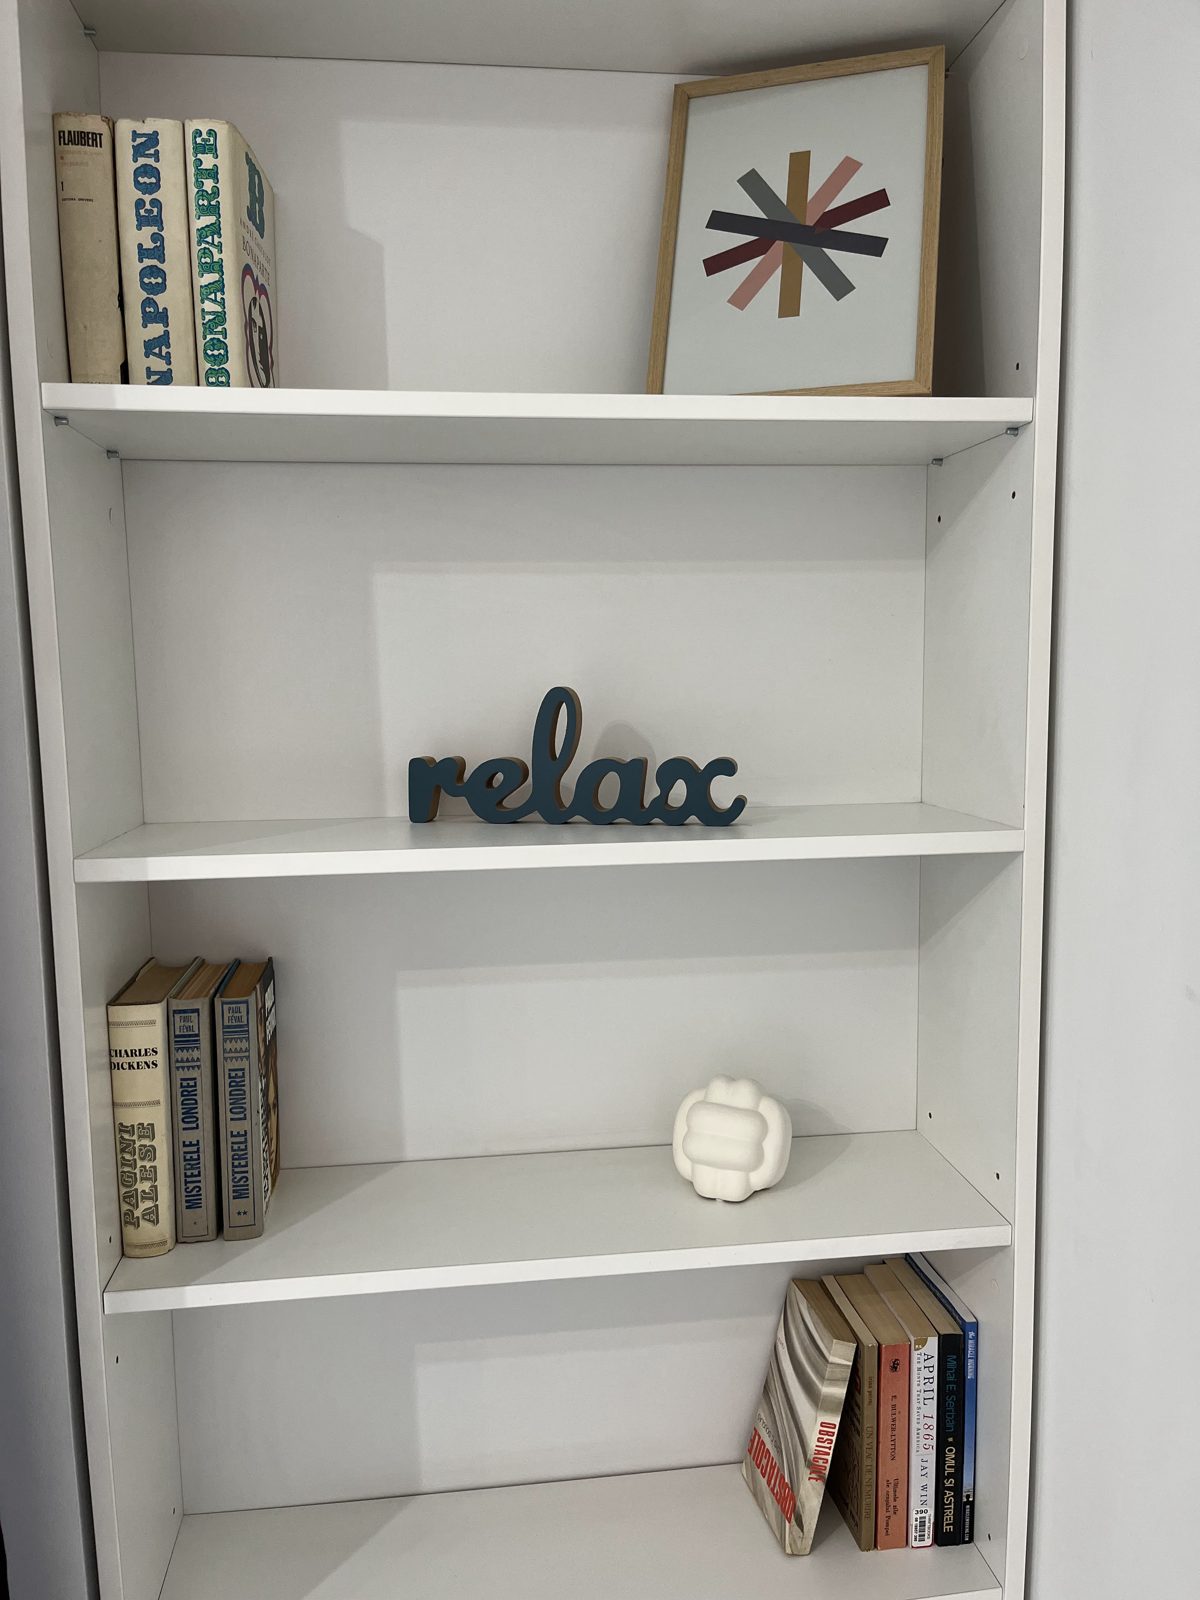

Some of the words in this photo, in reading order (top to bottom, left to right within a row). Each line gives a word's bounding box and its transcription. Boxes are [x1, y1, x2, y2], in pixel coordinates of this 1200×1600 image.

[58, 130, 104, 148] FLAUBERT
[131, 129, 174, 386] NAPOLEON
[191, 128, 231, 387] BONAPARTE
[408, 686, 748, 826] relax
[179, 1015, 193, 1024] PAUL
[227, 1006, 242, 1015] PAUL
[109, 1046, 159, 1059] CHARLES
[109, 1059, 159, 1071] DICKENS
[179, 1077, 200, 1132] LONDREI
[228, 1068, 247, 1121] LONDREI
[118, 1121, 141, 1229] PAGINI
[136, 1122, 160, 1226] ALESE
[183, 1139, 202, 1210] MISTERELE
[230, 1129, 250, 1200] MISTERELE
[922, 1352, 935, 1406] APRIL
[946, 1355, 957, 1381] Mihai
[808, 1421, 837, 1484] OBSTACOLE
[922, 1414, 934, 1450] 1865
[920, 1458, 928, 1478] JAY
[945, 1446, 956, 1476] OMUL
[943, 1490, 955, 1533] ASTRELE
